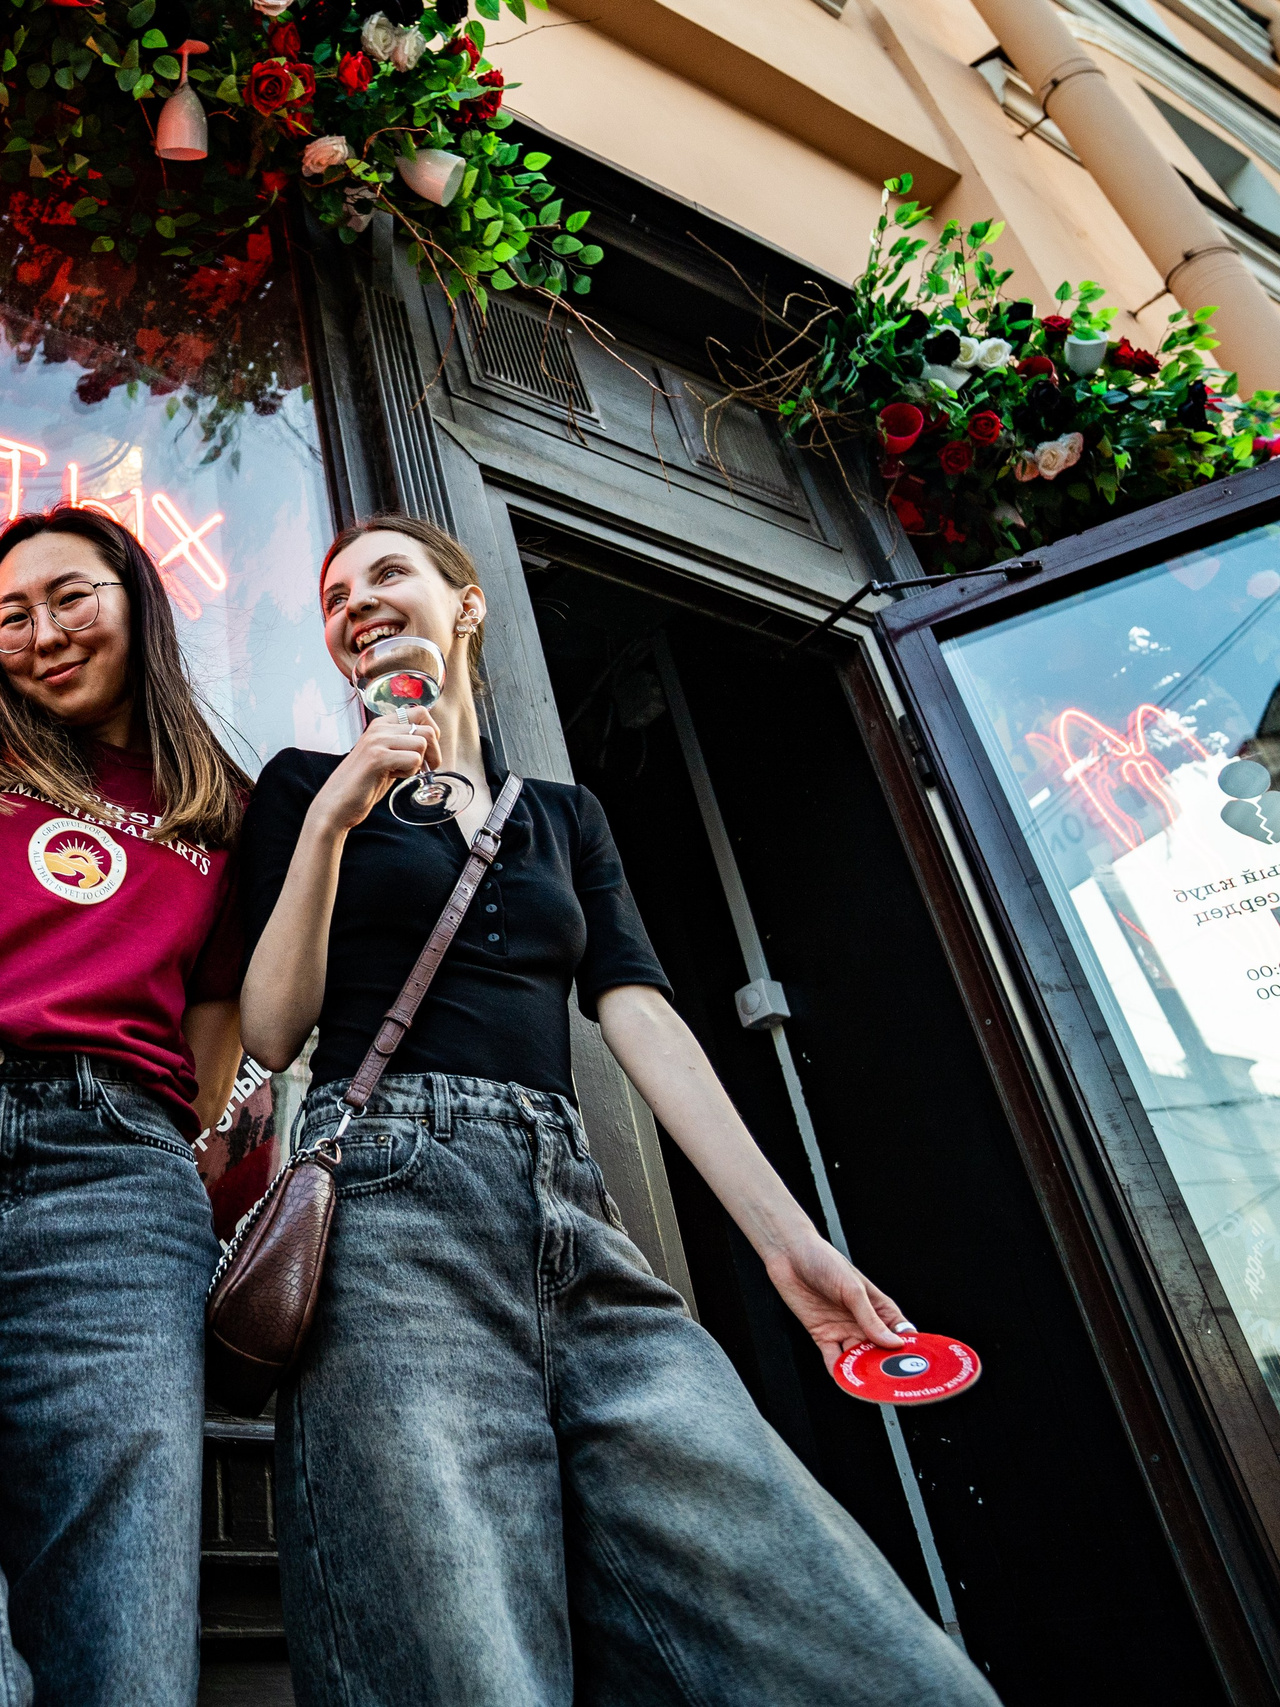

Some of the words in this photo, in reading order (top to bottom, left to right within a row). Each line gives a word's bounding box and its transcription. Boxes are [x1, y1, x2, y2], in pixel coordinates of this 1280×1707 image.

[41, 820, 83, 837] GRATEFUL
[84, 825, 101, 836] FOR
[37, 865, 55, 887] THAT
[55, 883, 62, 892] IS
[63, 888, 80, 899] YET
[82, 892, 94, 900] TO
[94, 879, 116, 898] COME
